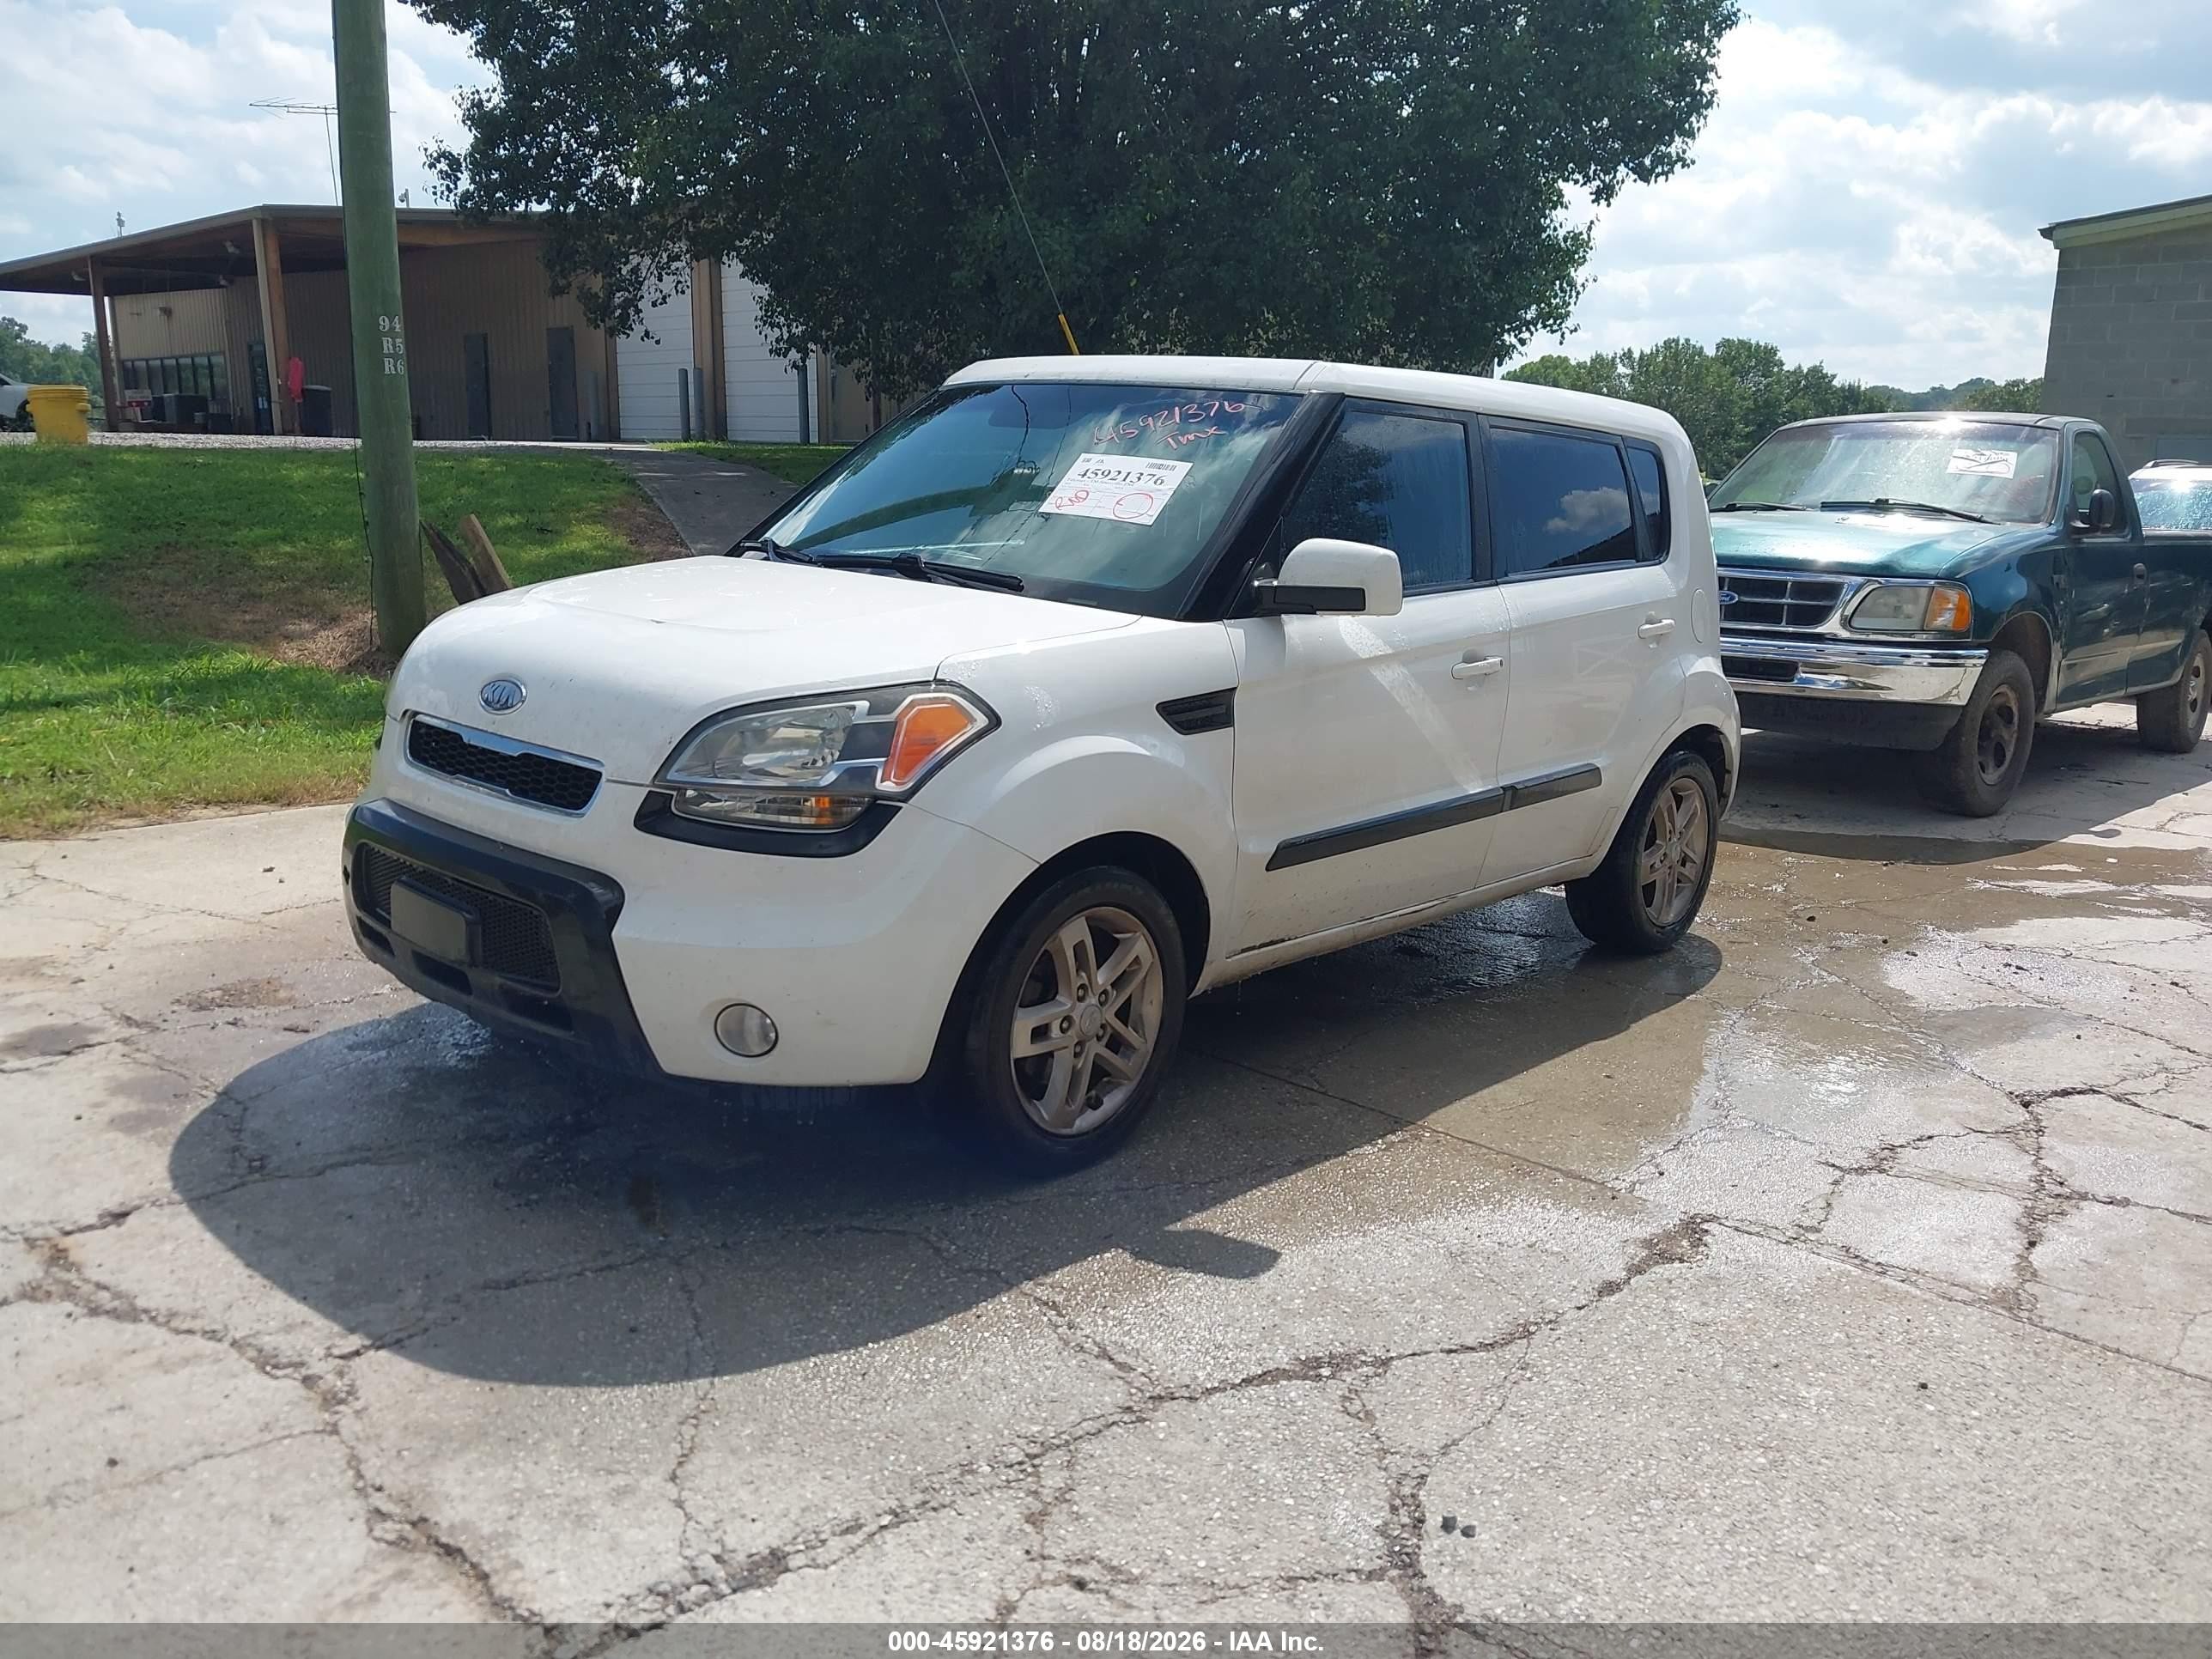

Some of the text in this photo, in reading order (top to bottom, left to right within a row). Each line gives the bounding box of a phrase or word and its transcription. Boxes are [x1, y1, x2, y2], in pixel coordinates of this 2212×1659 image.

[379, 315, 401, 331] 94
[381, 337, 404, 354] R5
[384, 357, 404, 374] R6
[1093, 400, 1245, 446] 45921376
[1078, 467, 1166, 487] 45921376
